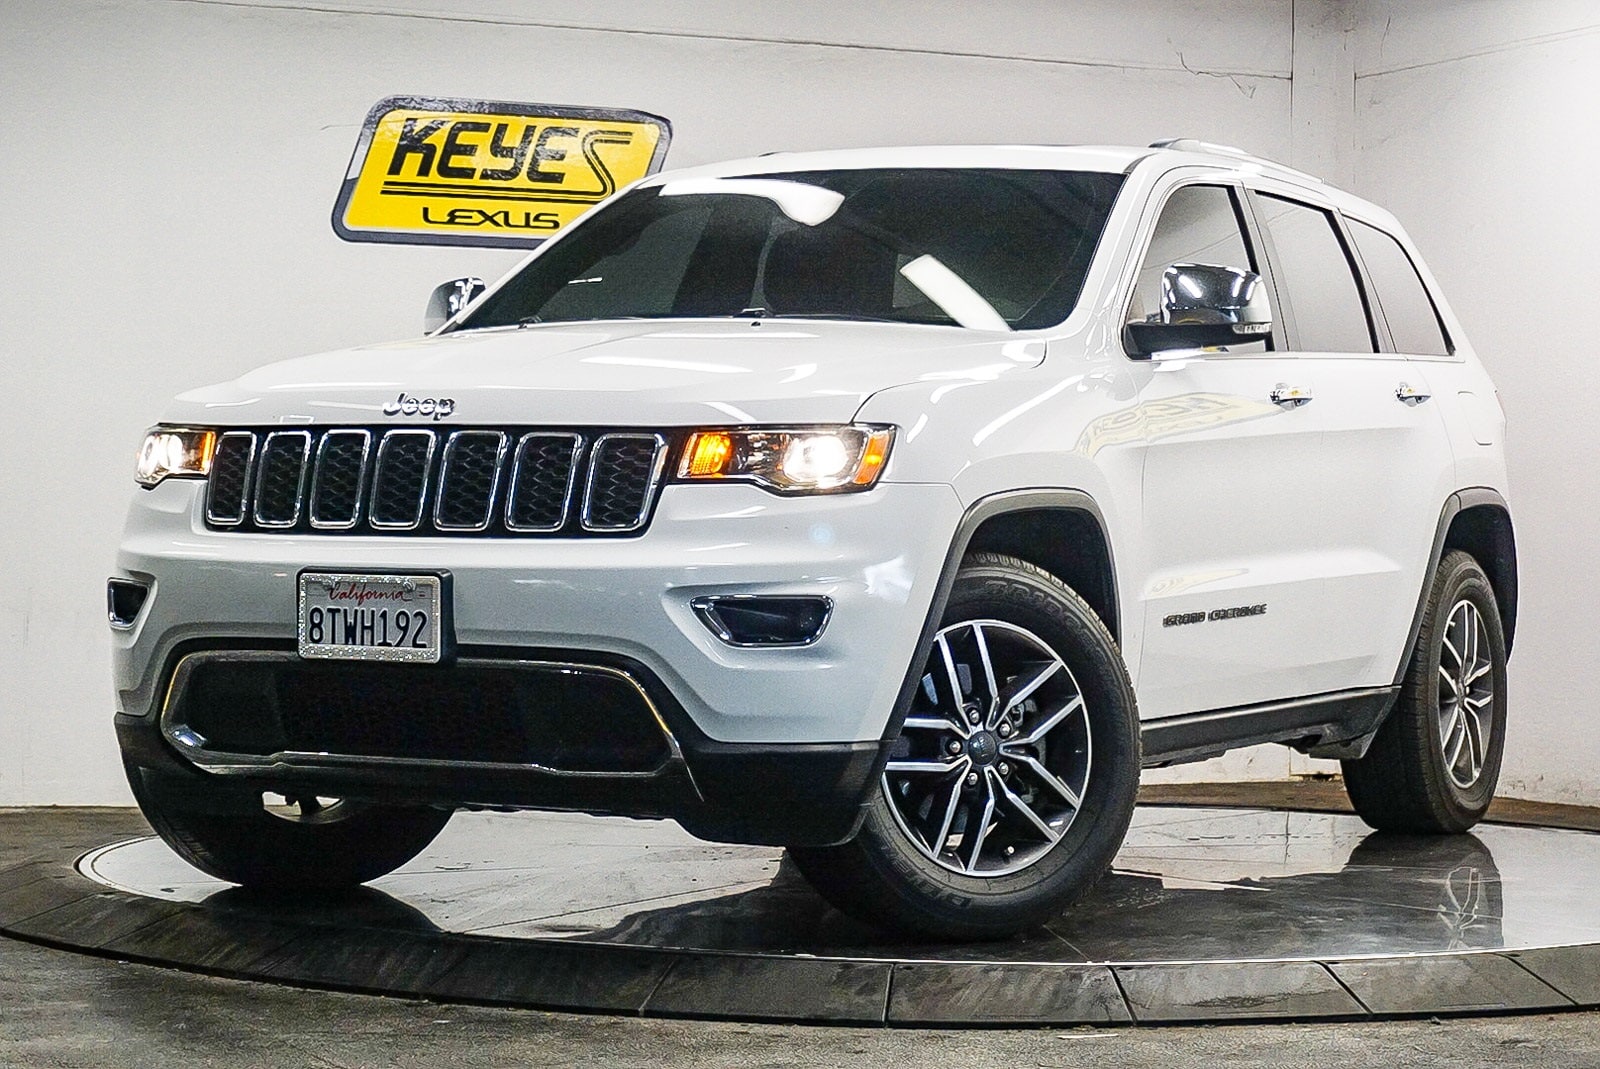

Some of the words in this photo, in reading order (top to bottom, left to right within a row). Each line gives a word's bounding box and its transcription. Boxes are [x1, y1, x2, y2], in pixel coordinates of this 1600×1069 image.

[381, 116, 634, 204] KEYES
[422, 206, 561, 230] LEXUS
[382, 392, 456, 421] Jeep
[328, 582, 413, 607] California
[308, 607, 428, 649] 8TWH192
[1162, 611, 1206, 628] GRAND
